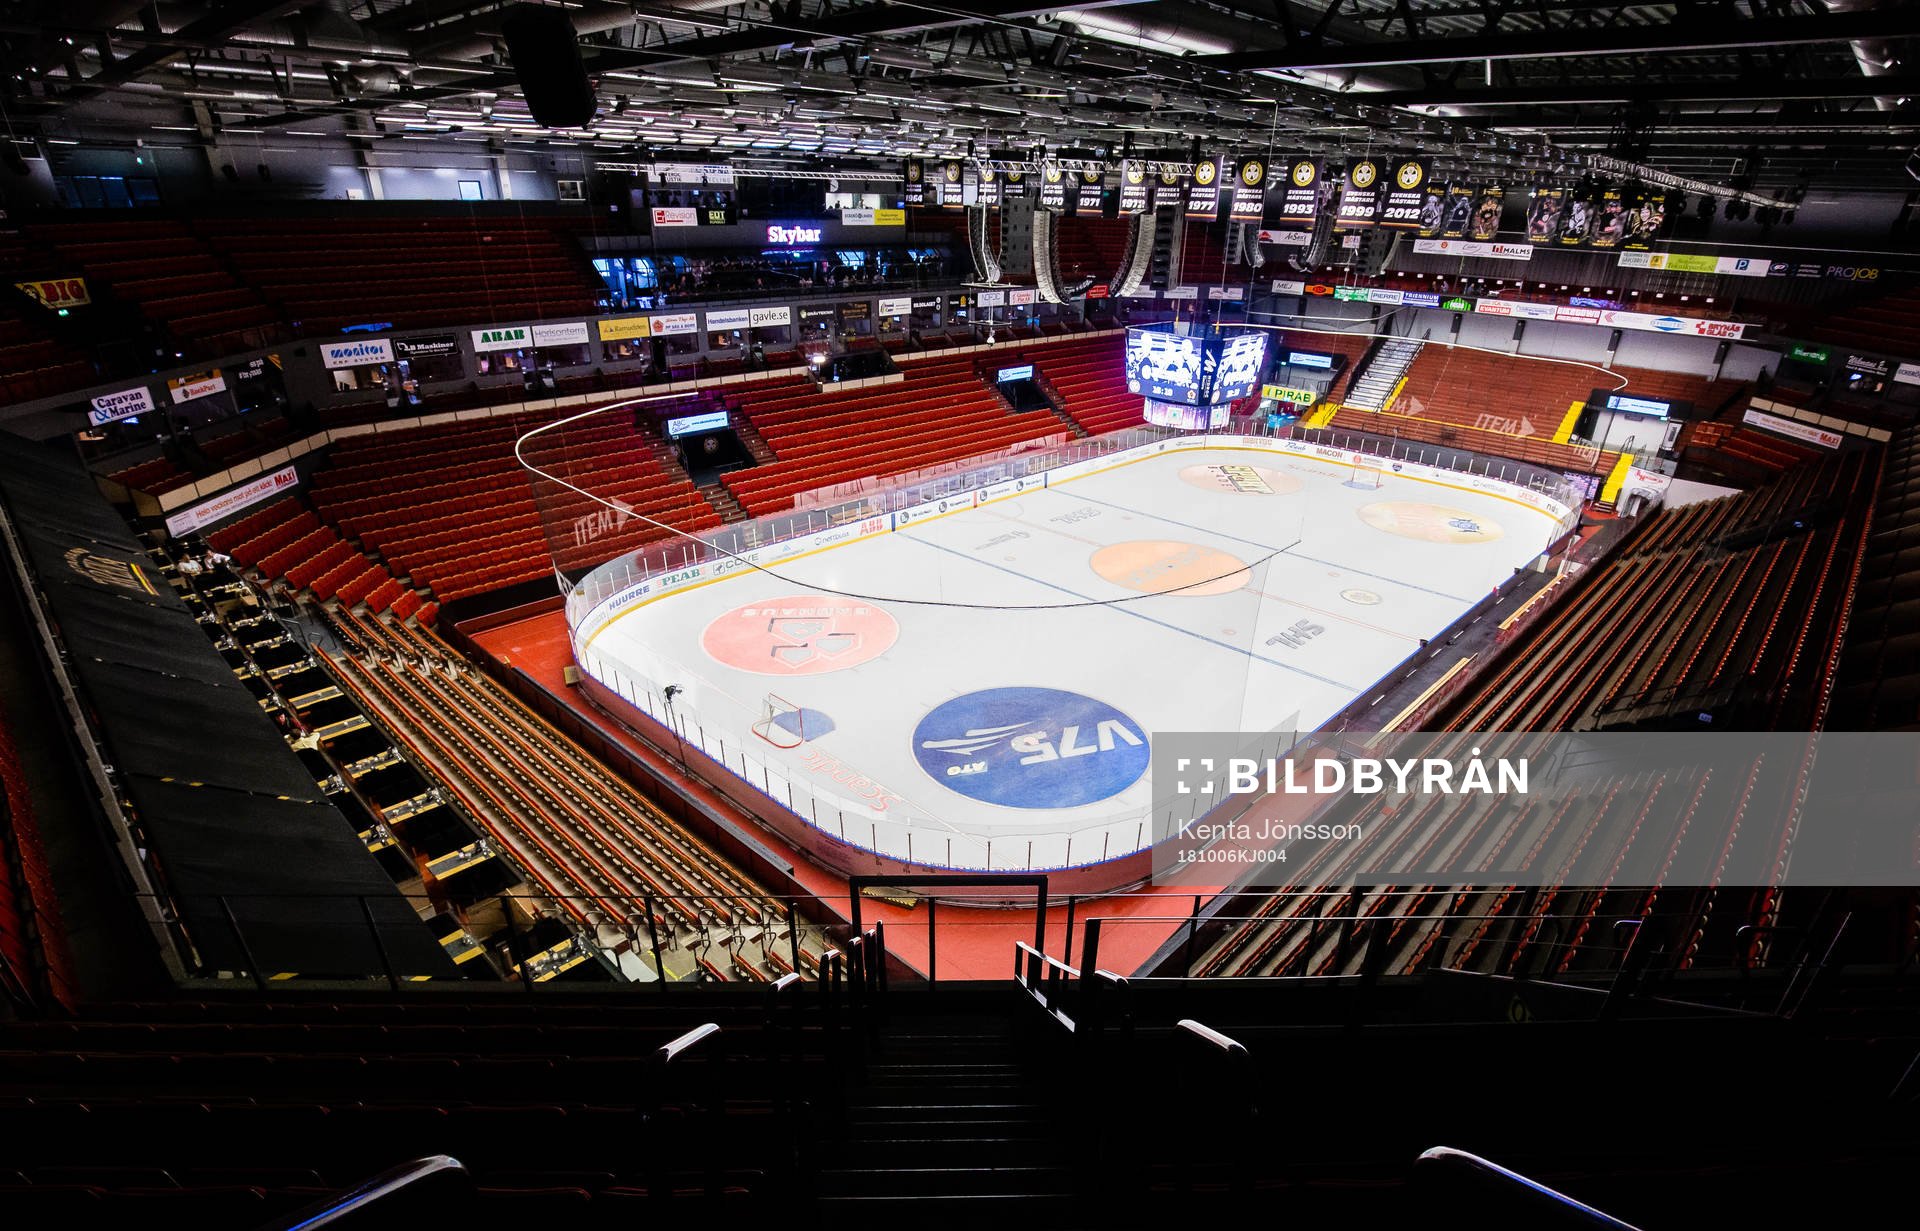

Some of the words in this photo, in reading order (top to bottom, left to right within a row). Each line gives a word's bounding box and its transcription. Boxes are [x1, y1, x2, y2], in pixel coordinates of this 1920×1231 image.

[1080, 197, 1100, 206] 1971
[1188, 201, 1215, 210] 1977
[1233, 202, 1263, 212] 1980
[1283, 203, 1314, 214] 1993
[1341, 205, 1375, 217] 1999
[1384, 208, 1421, 219] 2012
[767, 226, 820, 245] Skybar
[41, 280, 84, 302] BIG
[1404, 292, 1439, 301] TRIENNIUM
[1479, 305, 1511, 314] KVANTUM
[707, 316, 748, 325] Handelsbanken
[752, 311, 788, 324] gavle.se
[481, 329, 525, 343] ABAB
[331, 344, 383, 358] monitor
[97, 391, 143, 409] Caravan
[1274, 389, 1311, 403] PIRAB
[94, 406, 110, 421] &
[109, 401, 147, 418] Marine
[1474, 412, 1517, 436] ITEM
[1820, 433, 1839, 445] MAXI
[1316, 447, 1343, 459] MACON
[274, 471, 296, 486] MAXI
[575, 506, 613, 547] ITEM
[860, 518, 883, 535] ABB
[725, 553, 759, 569] COVE
[661, 569, 700, 587] PEAB
[609, 585, 650, 611] HUURRE
[1010, 718, 1144, 766] V75
[946, 760, 987, 776] ATG
[800, 746, 902, 812] Scandic
